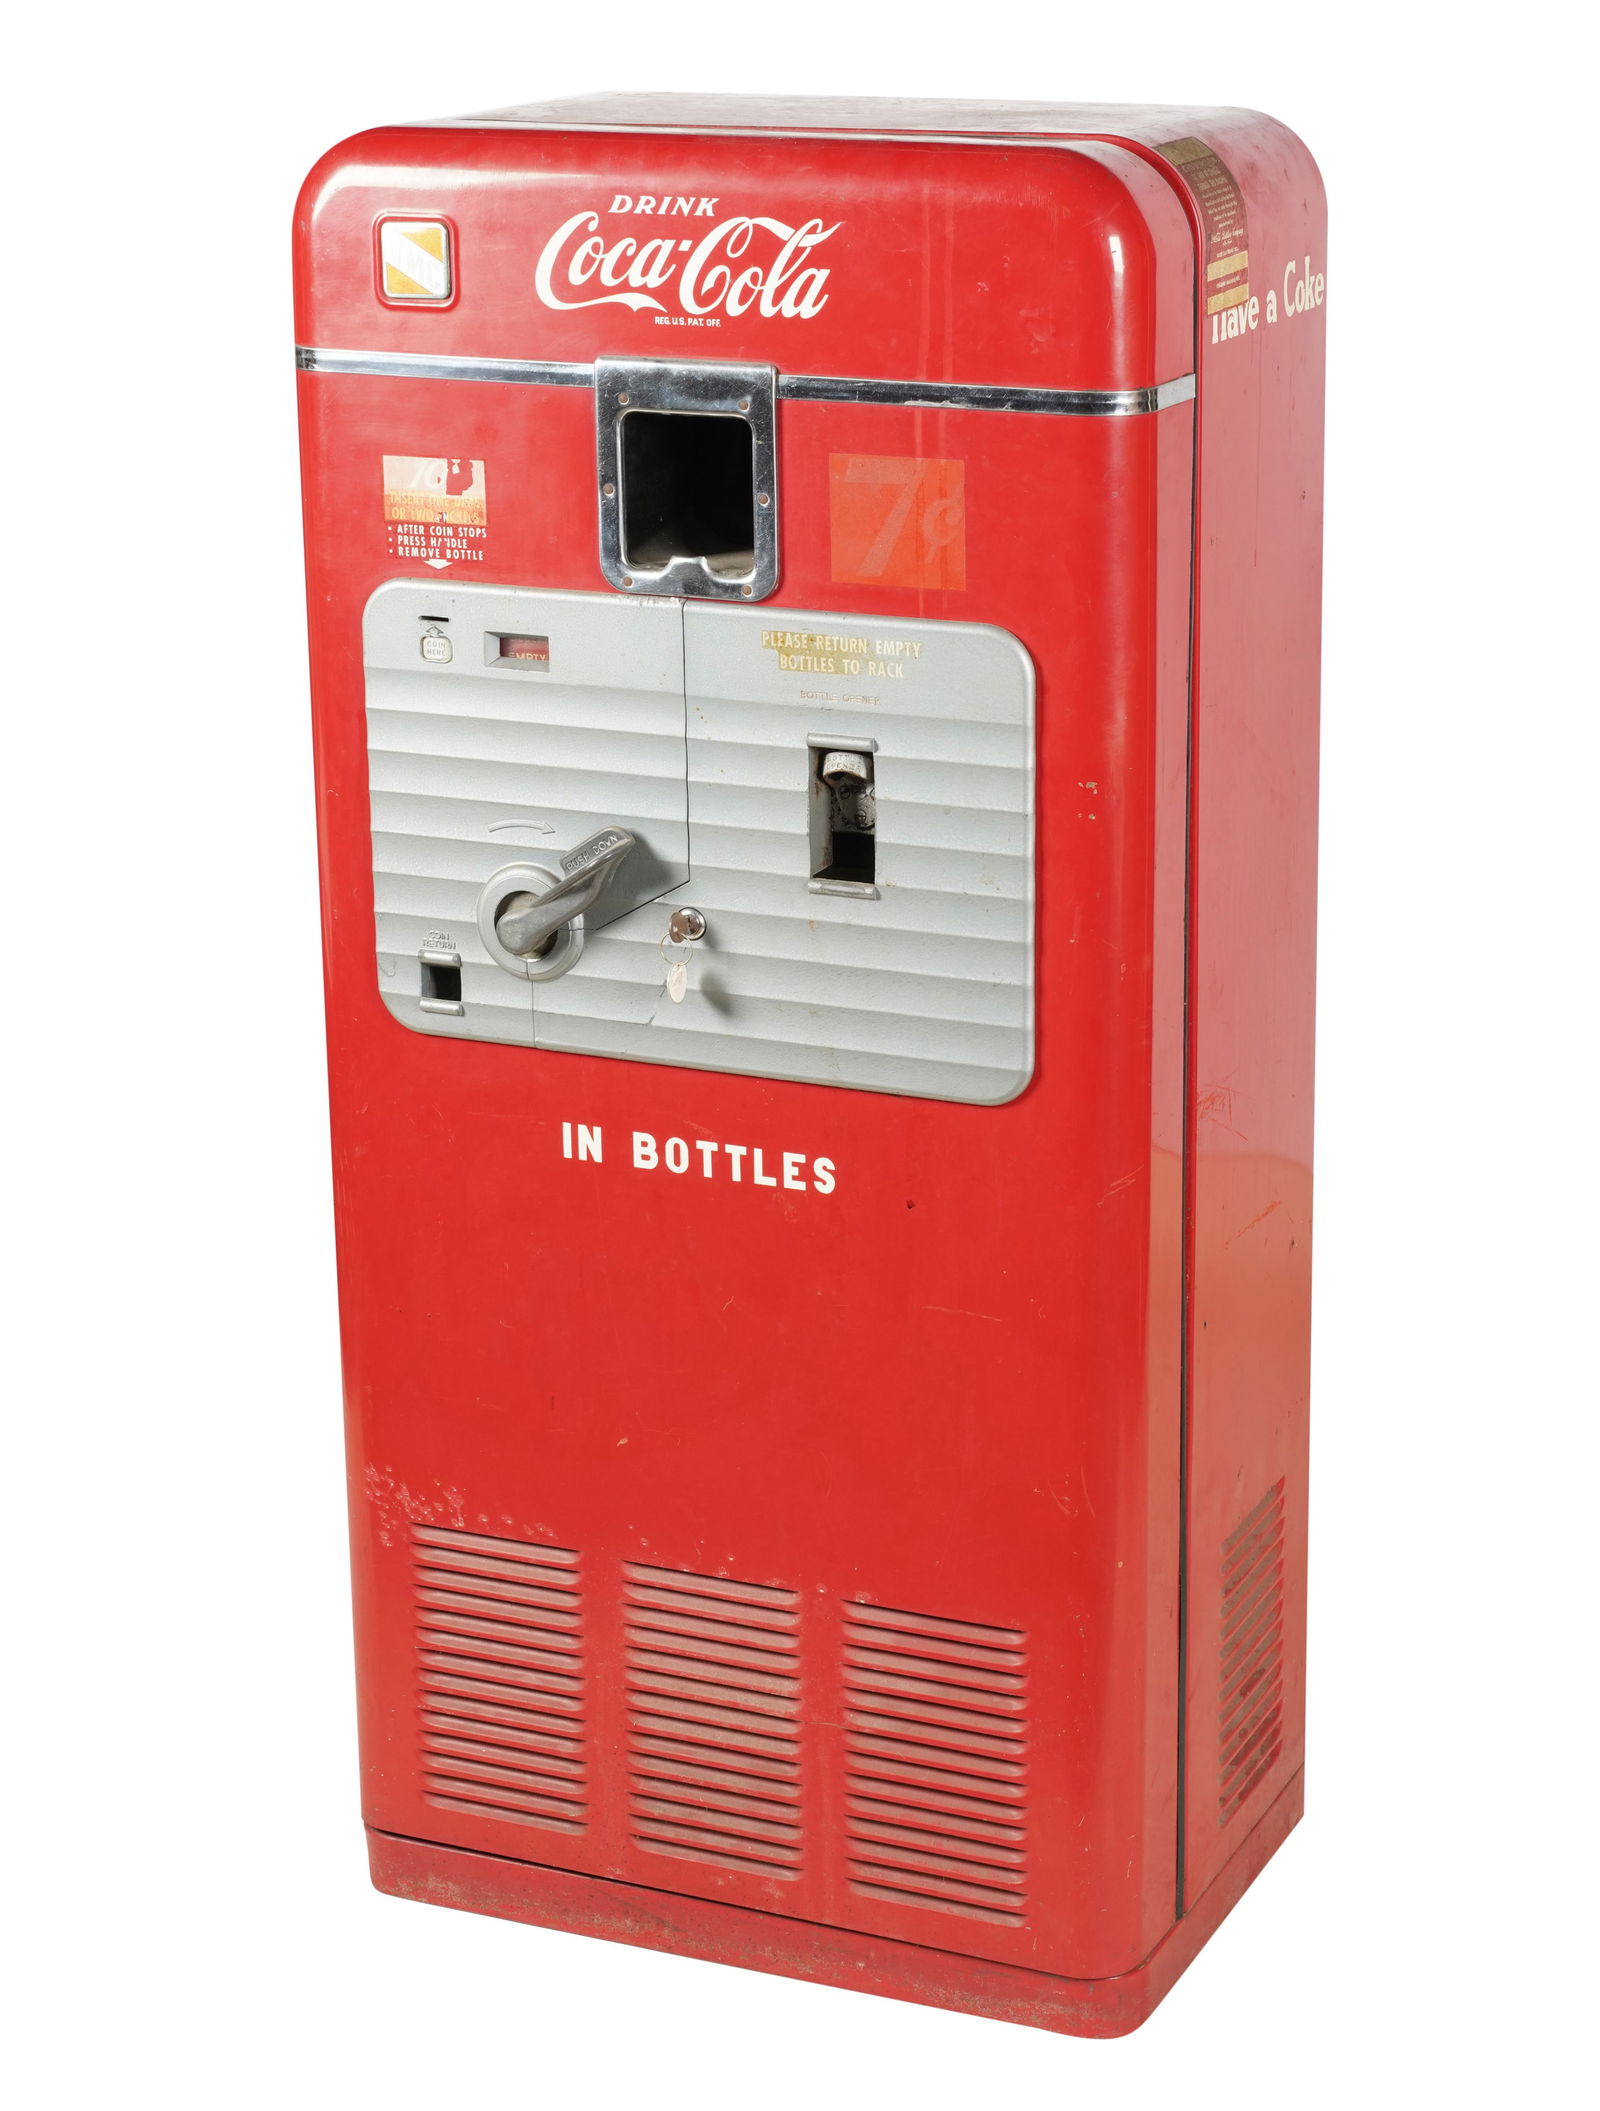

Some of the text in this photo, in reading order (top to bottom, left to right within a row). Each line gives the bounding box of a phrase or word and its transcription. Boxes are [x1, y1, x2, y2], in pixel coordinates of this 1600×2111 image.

[608, 194, 720, 217] DRINK
[535, 211, 845, 319] Coca-Cola
[1266, 289, 1278, 323] a
[1283, 255, 1325, 318] Coke
[391, 507, 406, 520] OR
[397, 524, 487, 538] AFTER COIN STOPS
[398, 535, 426, 547] PRESS
[398, 546, 483, 561] REMOVE BOTTLE
[762, 631, 922, 658] PLEASE RETURN EMPTY
[780, 654, 904, 678] BOTTLES TO RACK
[566, 834, 619, 872] PUSH DOWN
[562, 1121, 836, 1195] IN BOTTLES
